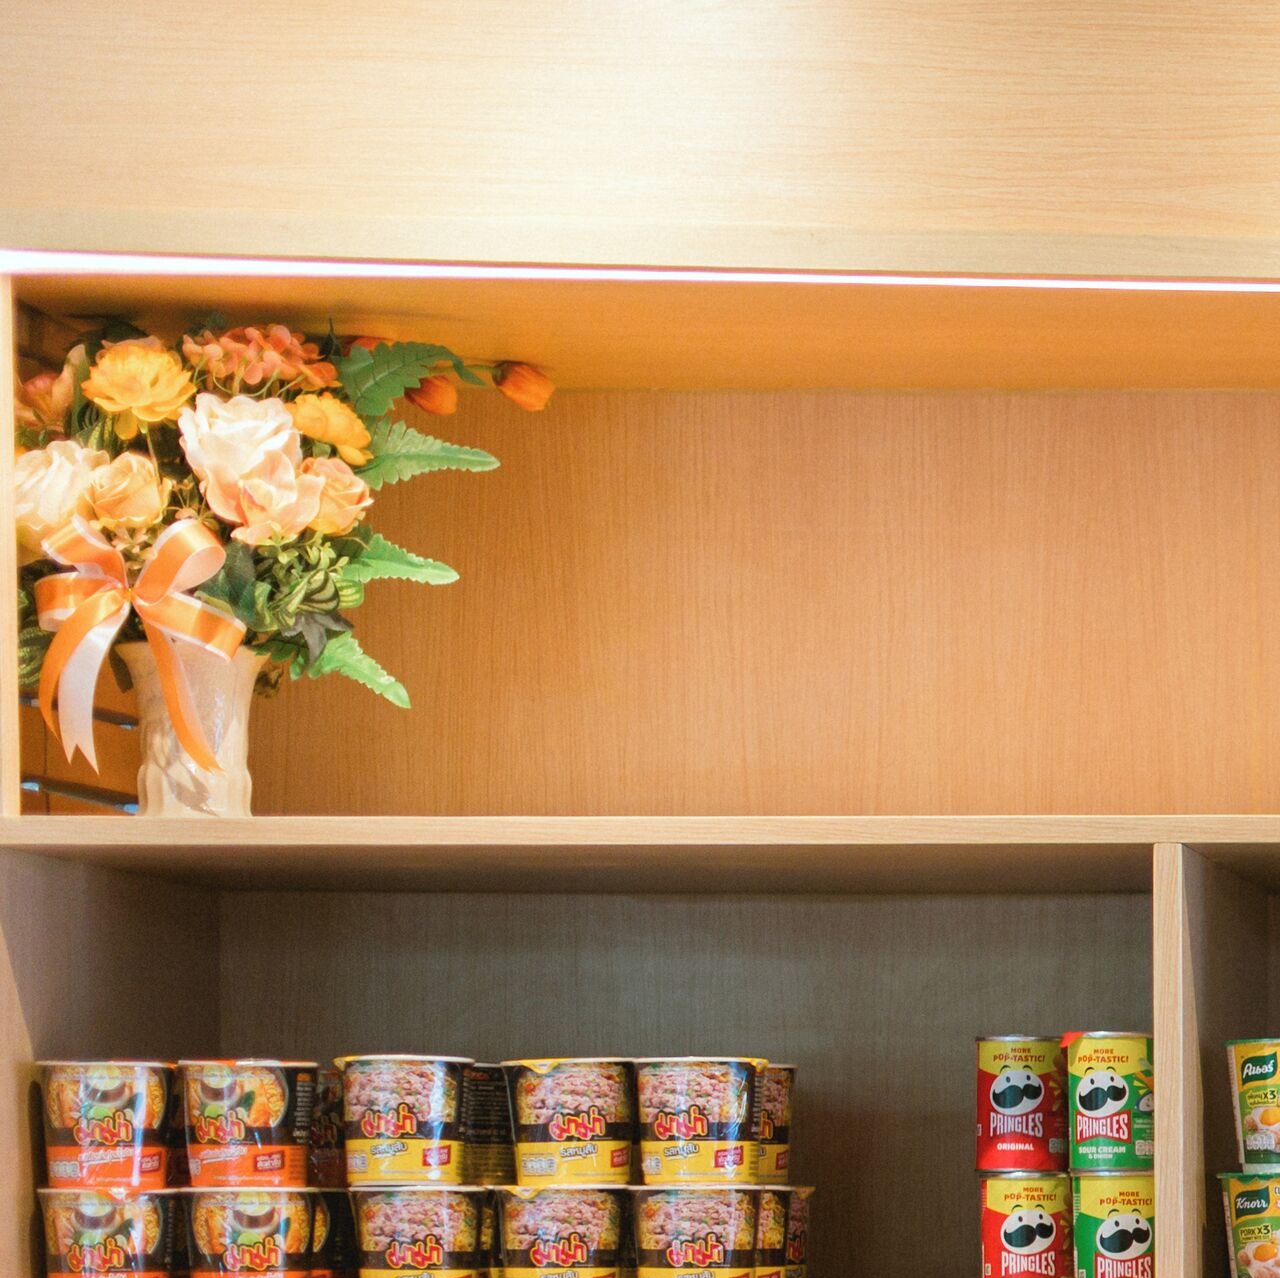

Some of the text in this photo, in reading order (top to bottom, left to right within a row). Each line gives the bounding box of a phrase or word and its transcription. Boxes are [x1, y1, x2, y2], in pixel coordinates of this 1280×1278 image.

[549, 1106, 605, 1140] มาม่า
[655, 1105, 707, 1140] มาม่า
[990, 1112, 1043, 1138] PRINGLES
[1077, 1113, 1128, 1141] PRINGLES
[1236, 1197, 1268, 1209] Knorr
[385, 1235, 443, 1269] มาม่า
[530, 1233, 587, 1267] มาม่า
[666, 1233, 724, 1267] มาม่า
[1001, 1251, 1055, 1276] PRINGLES
